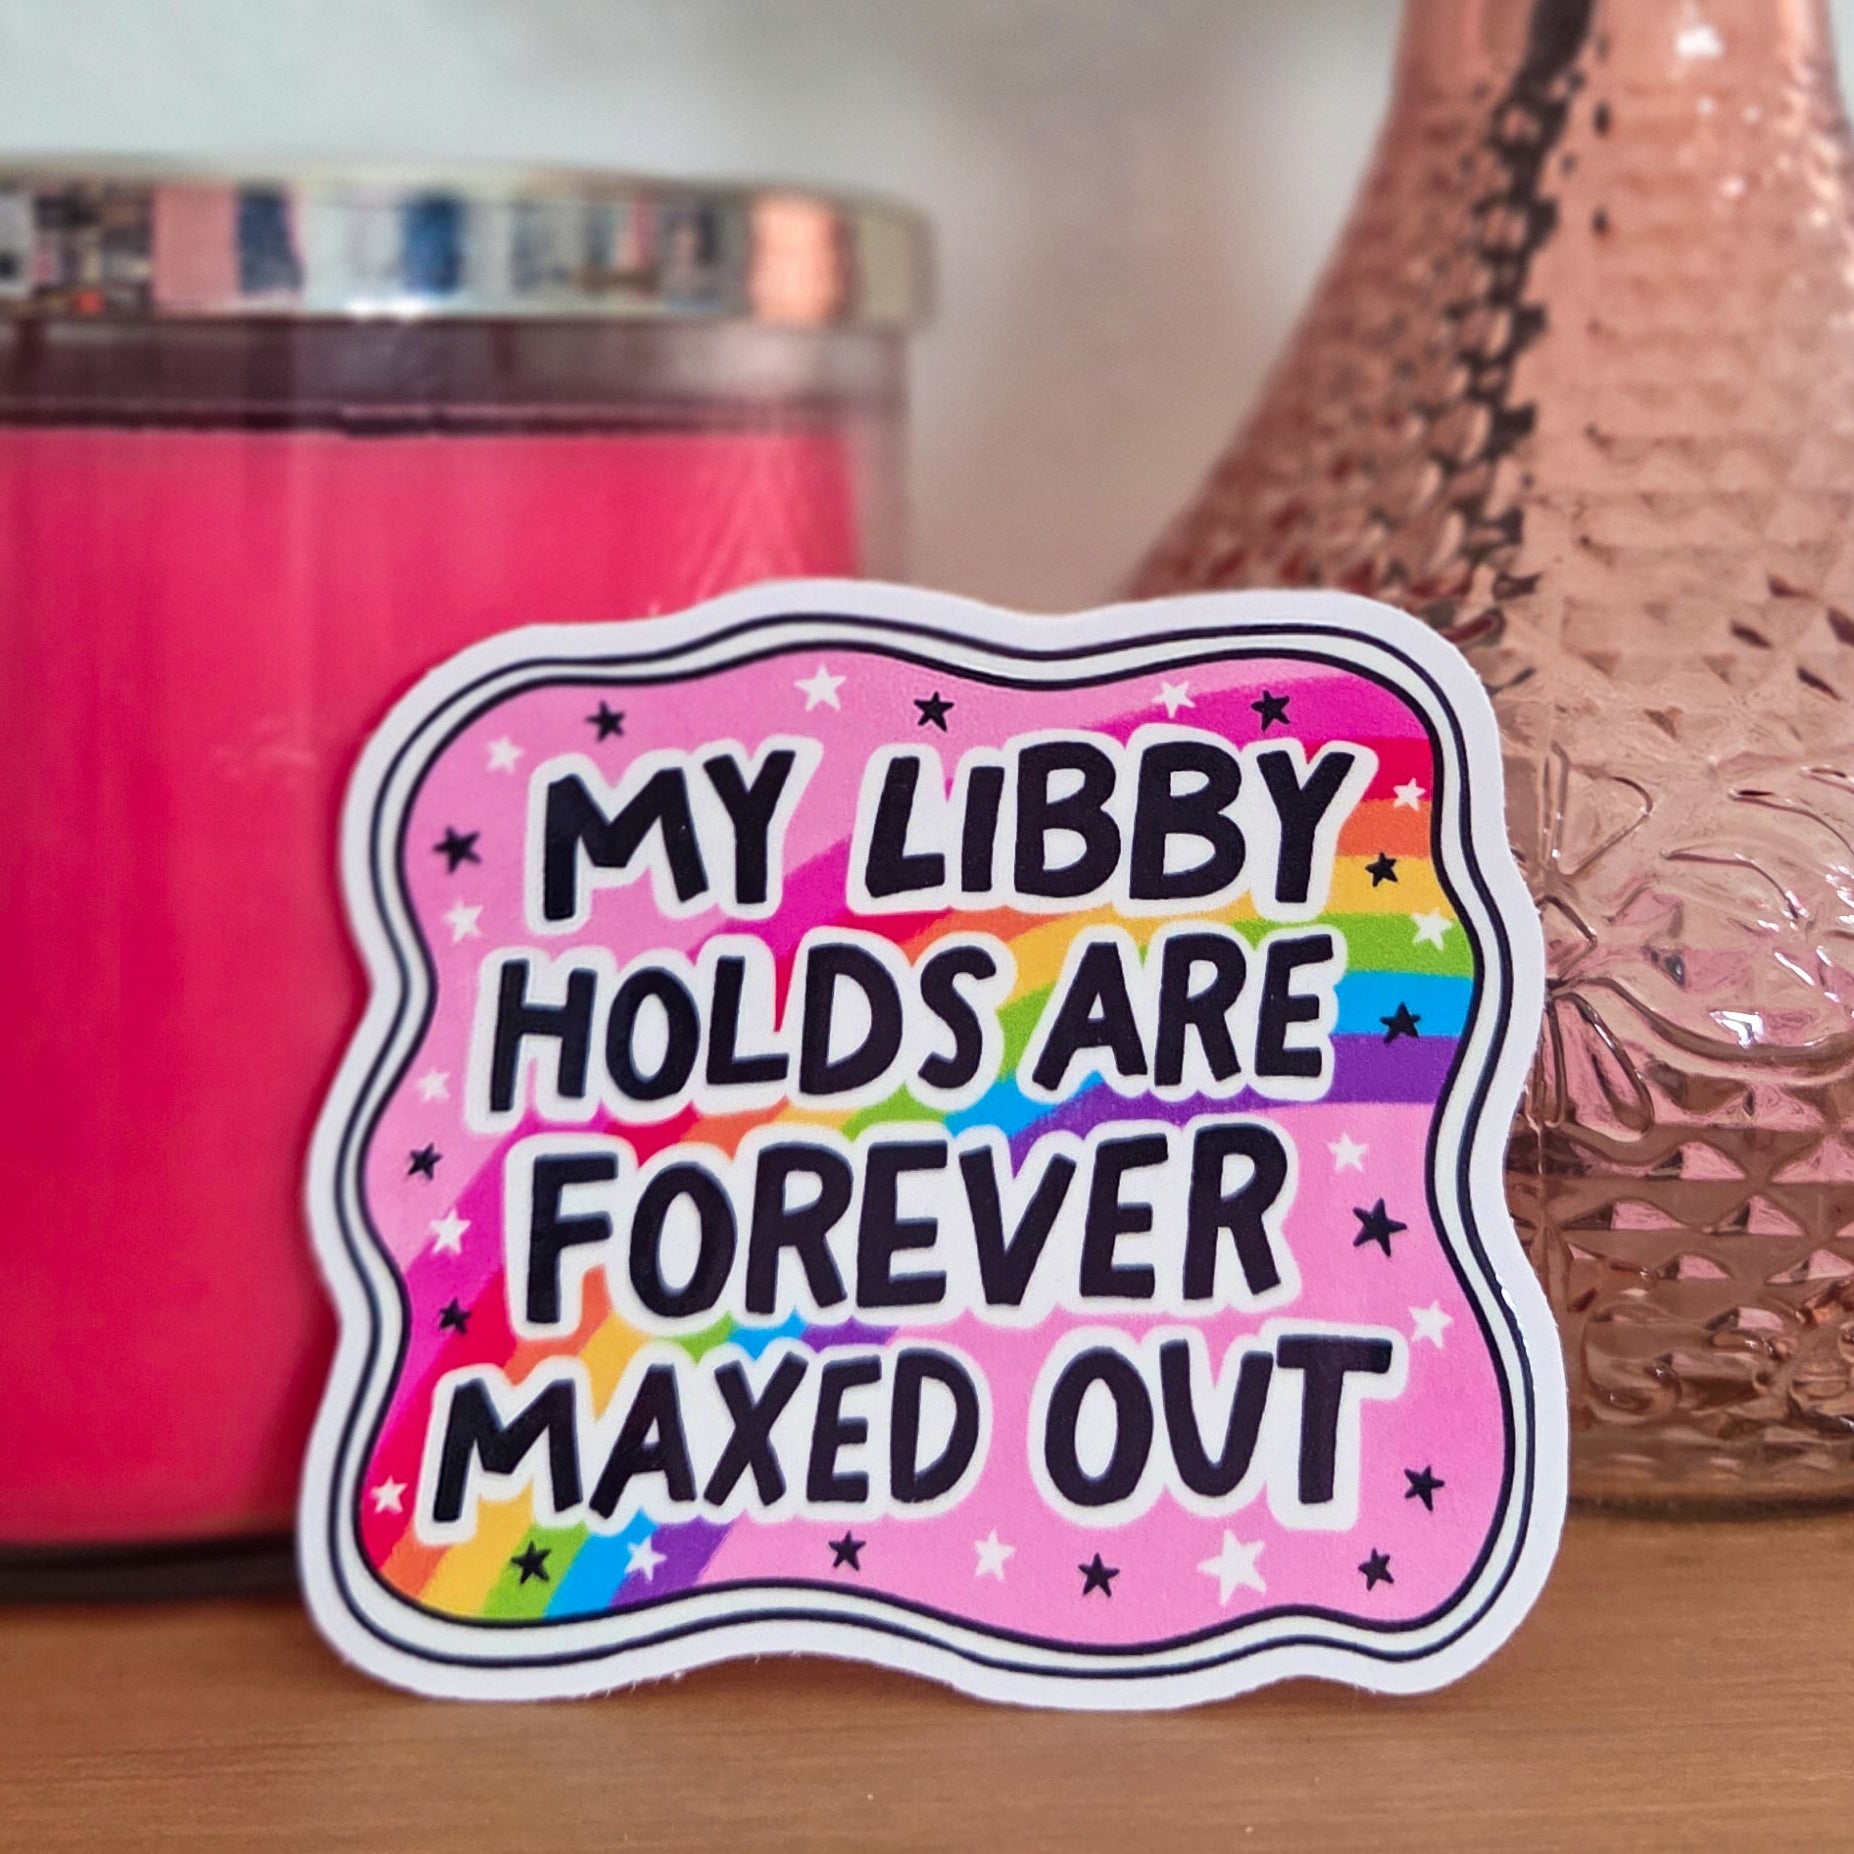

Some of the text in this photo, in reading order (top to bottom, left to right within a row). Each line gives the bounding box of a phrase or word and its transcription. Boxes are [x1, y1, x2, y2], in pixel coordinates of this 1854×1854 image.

[543, 741, 1355, 921] MY LIBBY
[489, 933, 1334, 1113] HOLDS ARE
[526, 1125, 1289, 1324] FOREVER
[432, 1337, 1394, 1523] MAXED OUT
